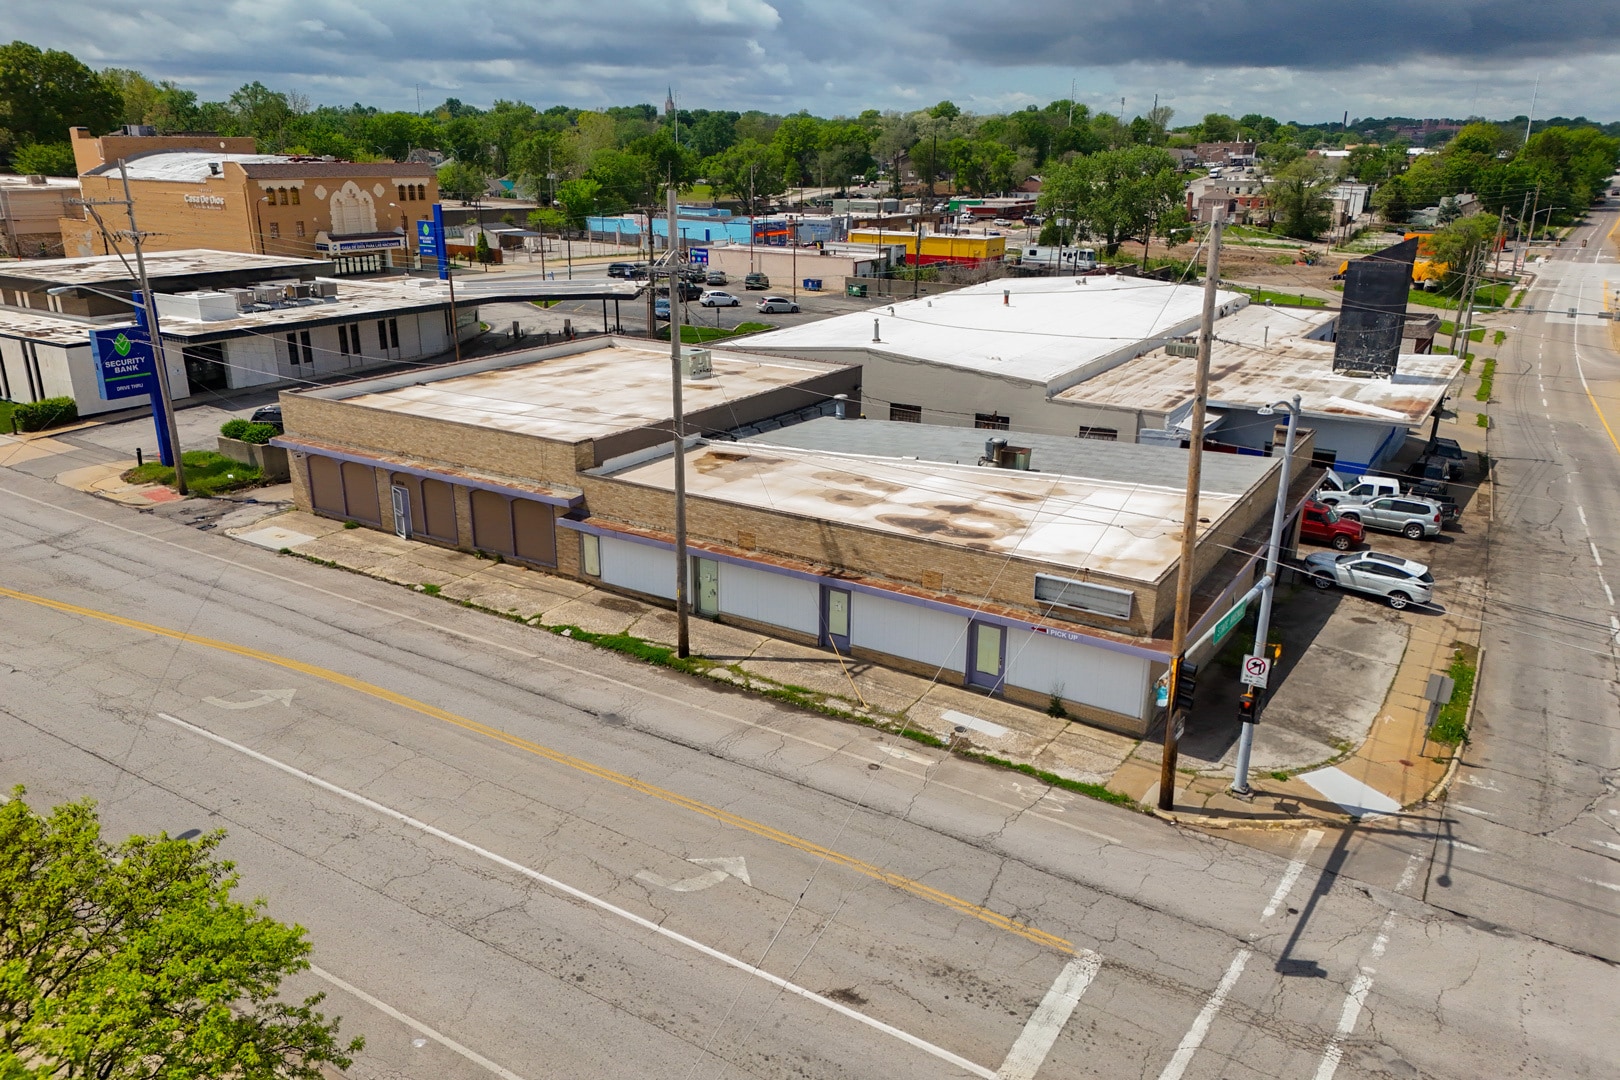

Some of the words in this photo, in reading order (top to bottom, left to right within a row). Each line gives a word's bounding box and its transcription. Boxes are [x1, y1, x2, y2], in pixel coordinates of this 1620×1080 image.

[184, 194, 200, 202] Casa
[105, 356, 145, 368] SECURITY
[114, 364, 139, 374] BANK
[1050, 629, 1067, 638] PICK
